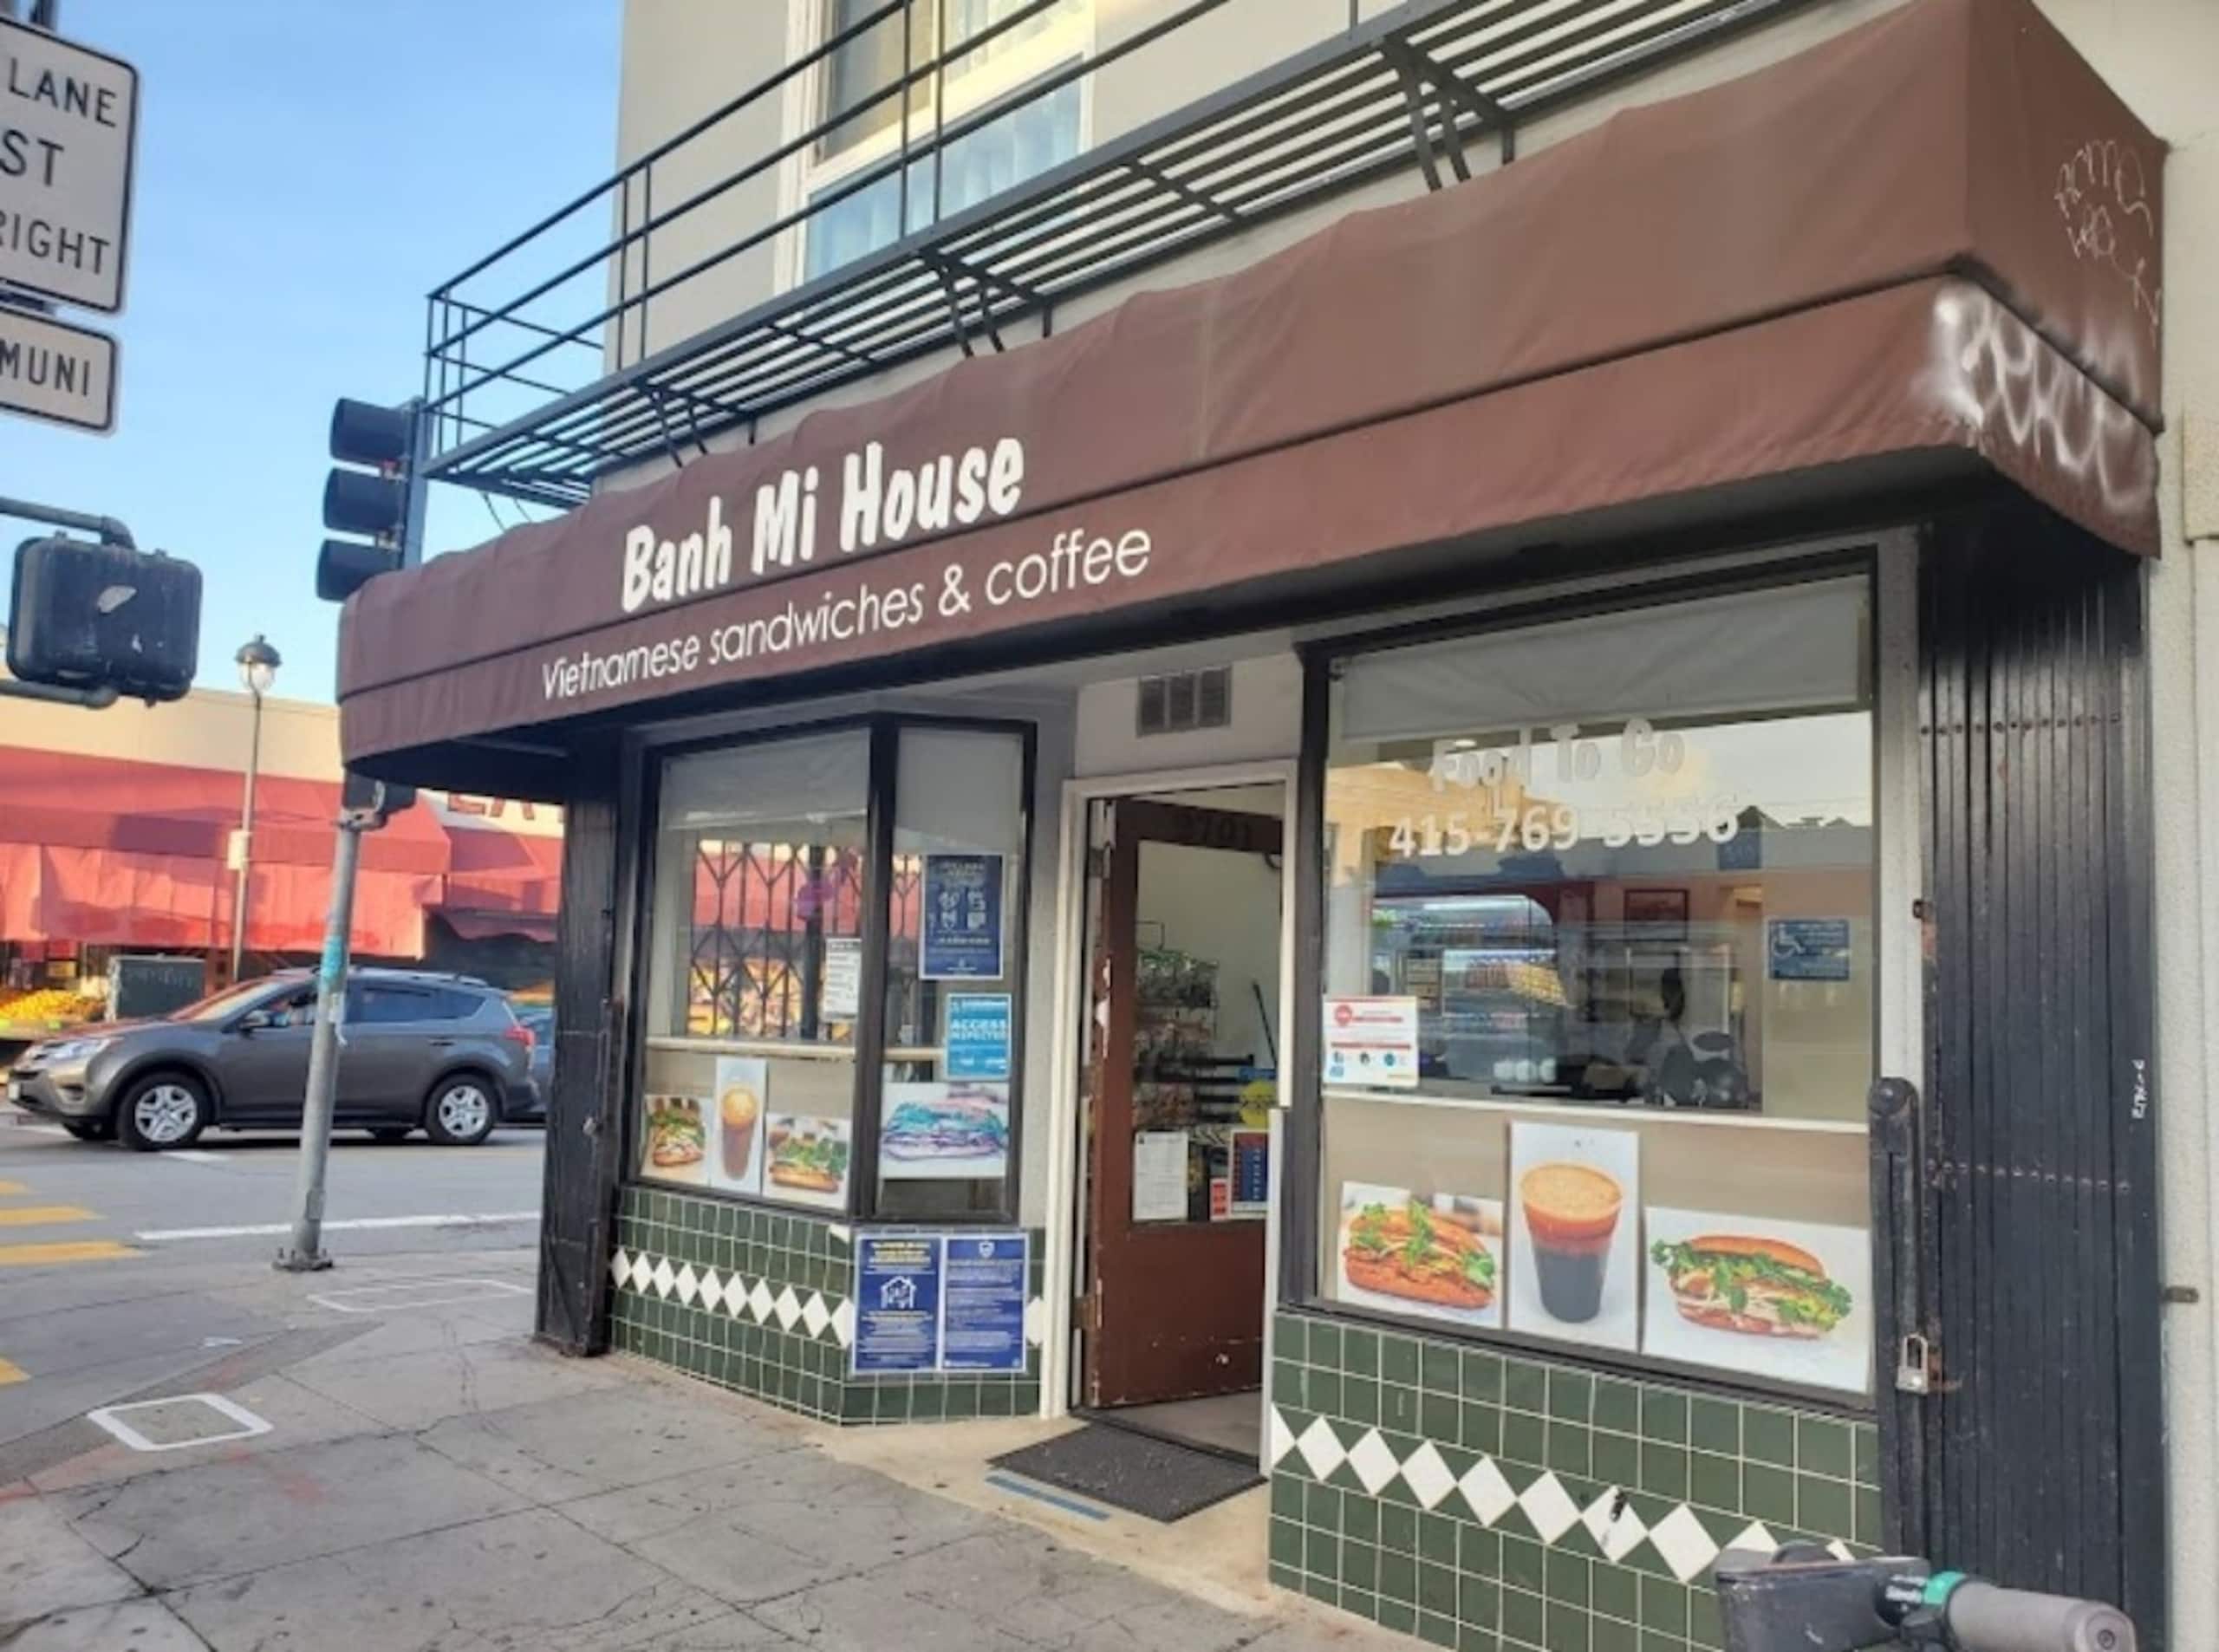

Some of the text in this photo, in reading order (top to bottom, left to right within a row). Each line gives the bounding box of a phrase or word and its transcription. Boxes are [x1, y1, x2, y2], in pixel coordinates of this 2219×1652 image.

[8, 56, 117, 128] LANE
[0, 339, 89, 396] MUNI
[621, 438, 1025, 612] Banh Mi House
[542, 527, 1152, 700] Vietnamese sandwiches & coffee
[1548, 722, 1602, 782] To
[1622, 718, 1686, 778] Go
